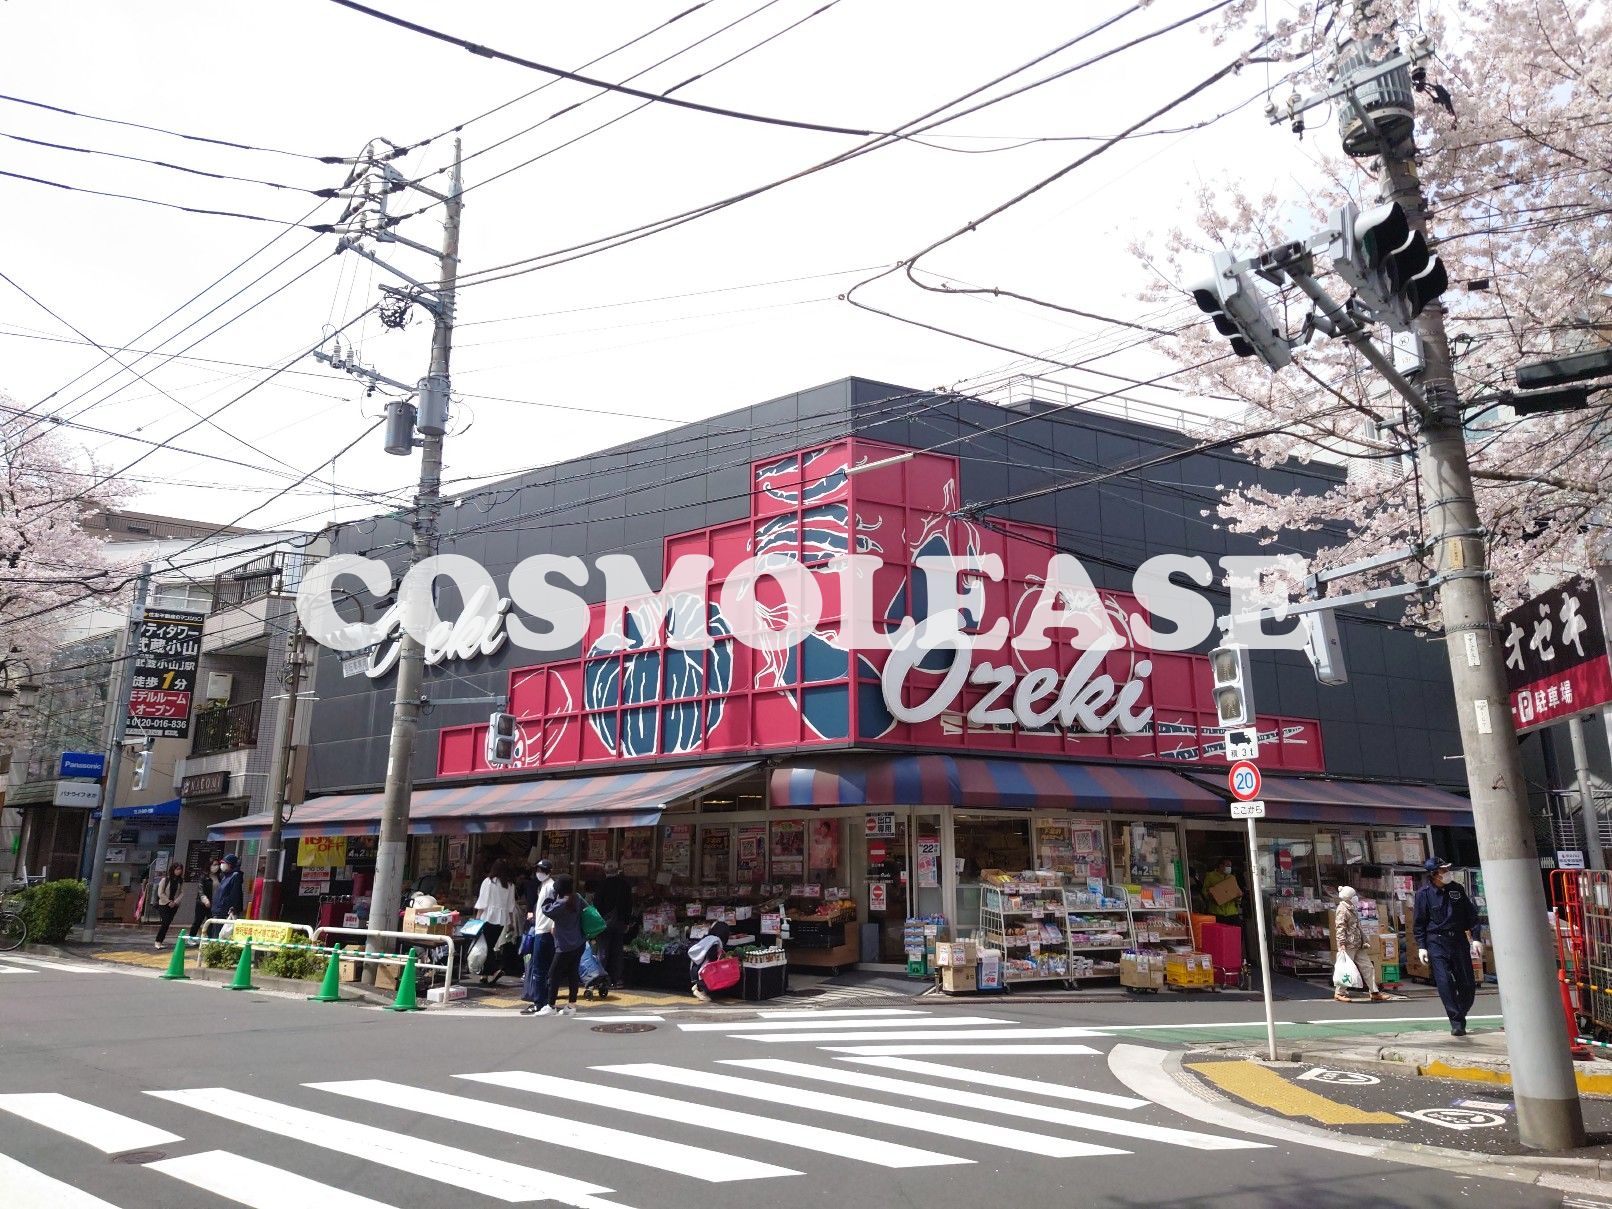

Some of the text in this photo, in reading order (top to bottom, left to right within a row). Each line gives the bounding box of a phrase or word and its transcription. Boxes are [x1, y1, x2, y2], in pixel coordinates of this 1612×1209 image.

[1504, 592, 1587, 670] オゼキ
[882, 609, 1154, 733] Ozeki
[1534, 679, 1573, 713] 駐車場
[135, 704, 176, 716] オープン
[131, 718, 187, 729] 0120-016-836
[65, 760, 102, 770] Panasonic
[1235, 771, 1254, 790] 20
[1233, 805, 1262, 815] ここから
[877, 816, 892, 824] 出口
[318, 841, 345, 852] OFF
